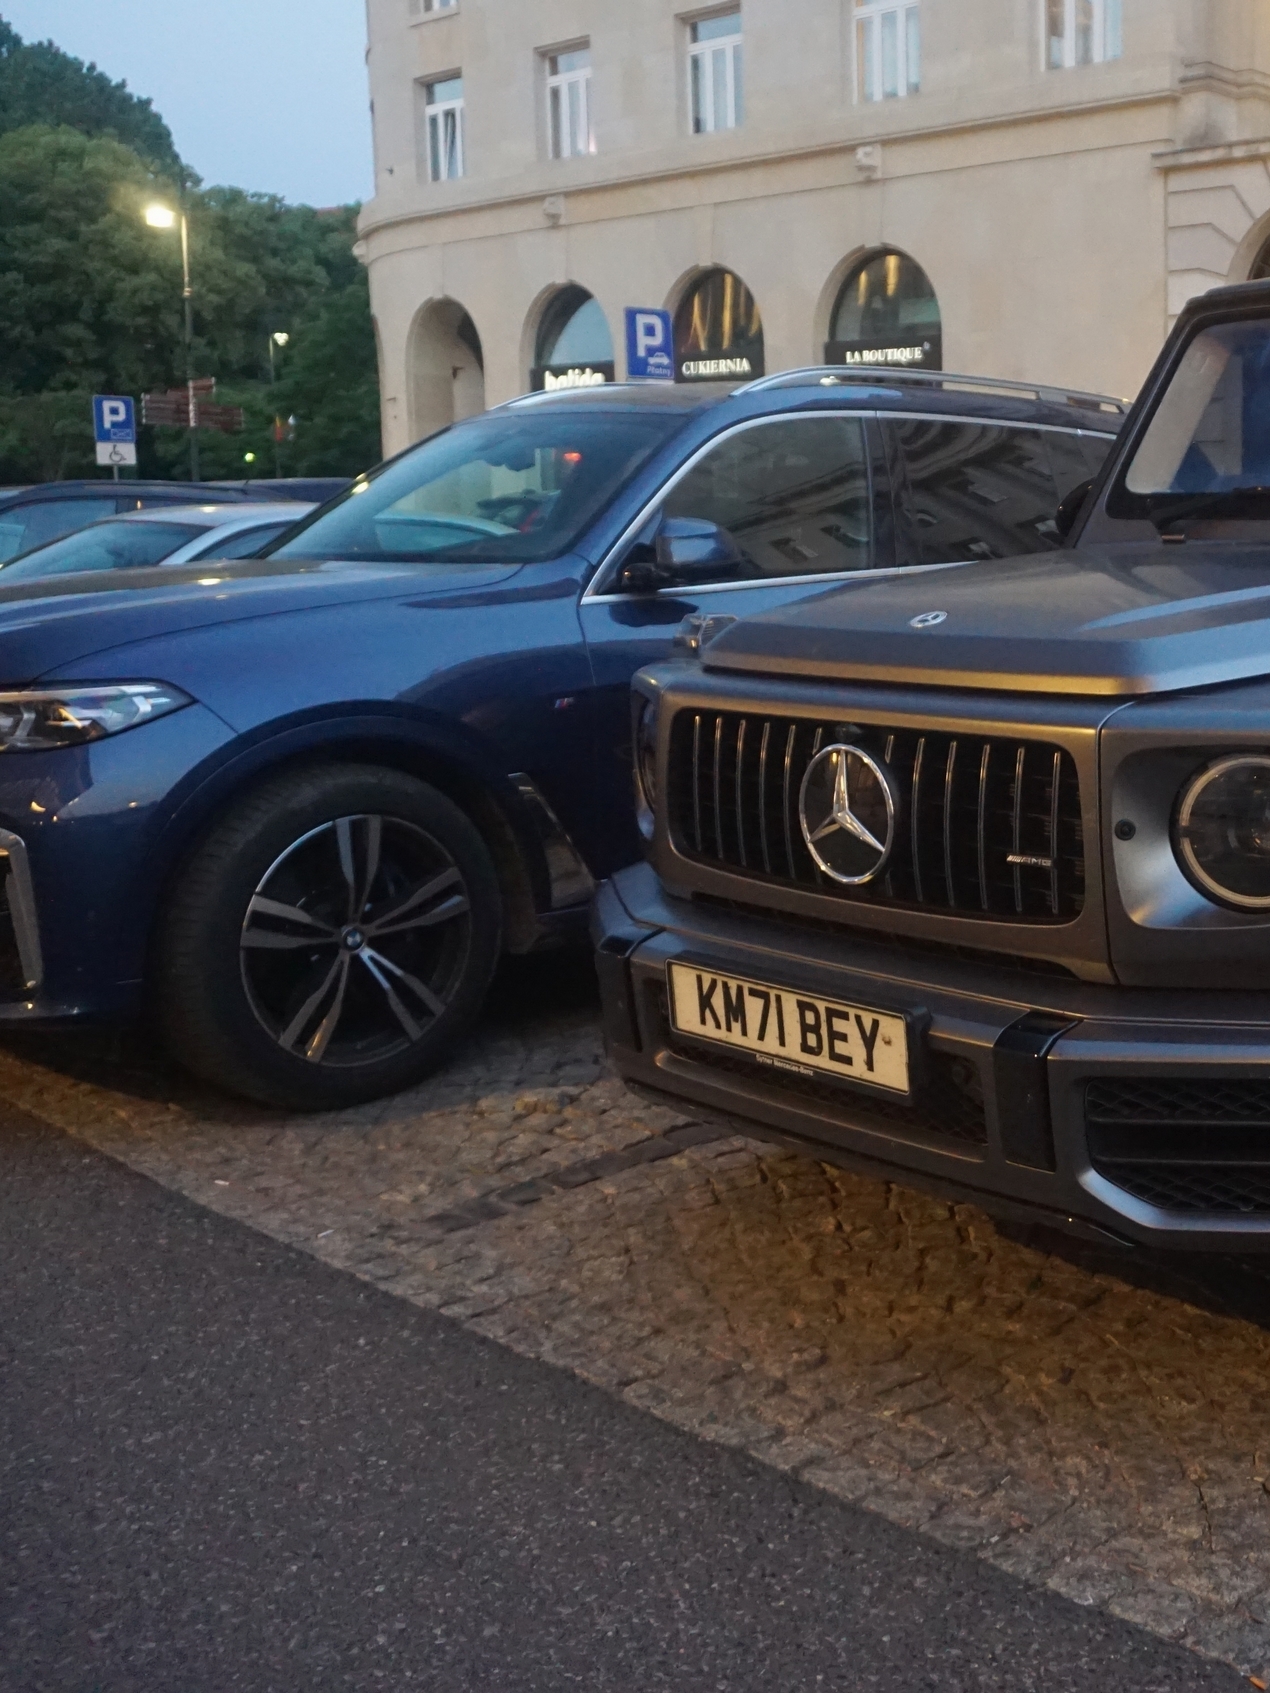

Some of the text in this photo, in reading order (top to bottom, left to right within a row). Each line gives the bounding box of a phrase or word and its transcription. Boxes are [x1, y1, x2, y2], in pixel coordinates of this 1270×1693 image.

[635, 313, 664, 357] P
[682, 357, 751, 378] CUKIERNIA
[846, 346, 923, 365] LA BOUTIQUE
[102, 400, 126, 429] P
[696, 974, 880, 1072] KM71 BEY
